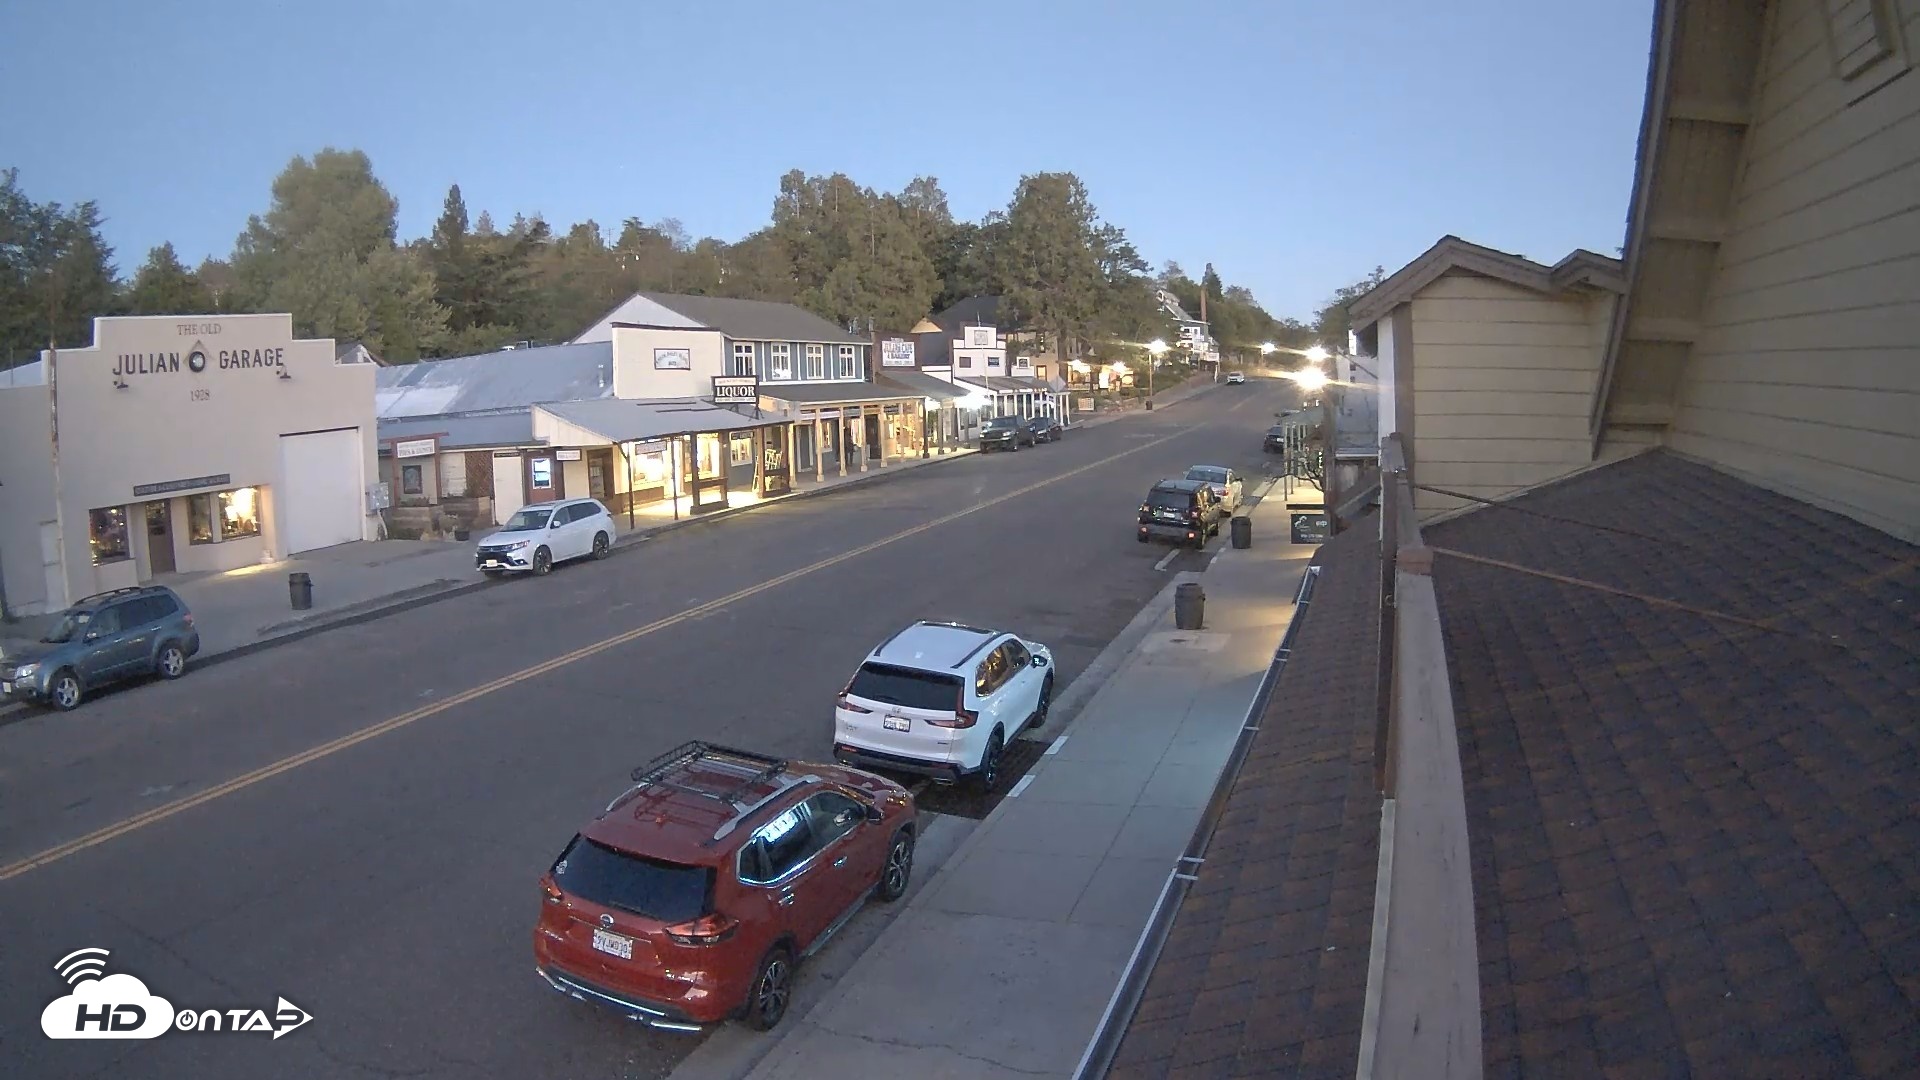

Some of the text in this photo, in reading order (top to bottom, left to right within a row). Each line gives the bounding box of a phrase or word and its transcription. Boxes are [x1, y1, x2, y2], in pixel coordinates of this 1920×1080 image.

[177, 323, 222, 336] THE OLD
[113, 348, 284, 376] JULIAN GARAGE
[190, 390, 210, 401] 1928
[716, 386, 755, 398] LIQUOR
